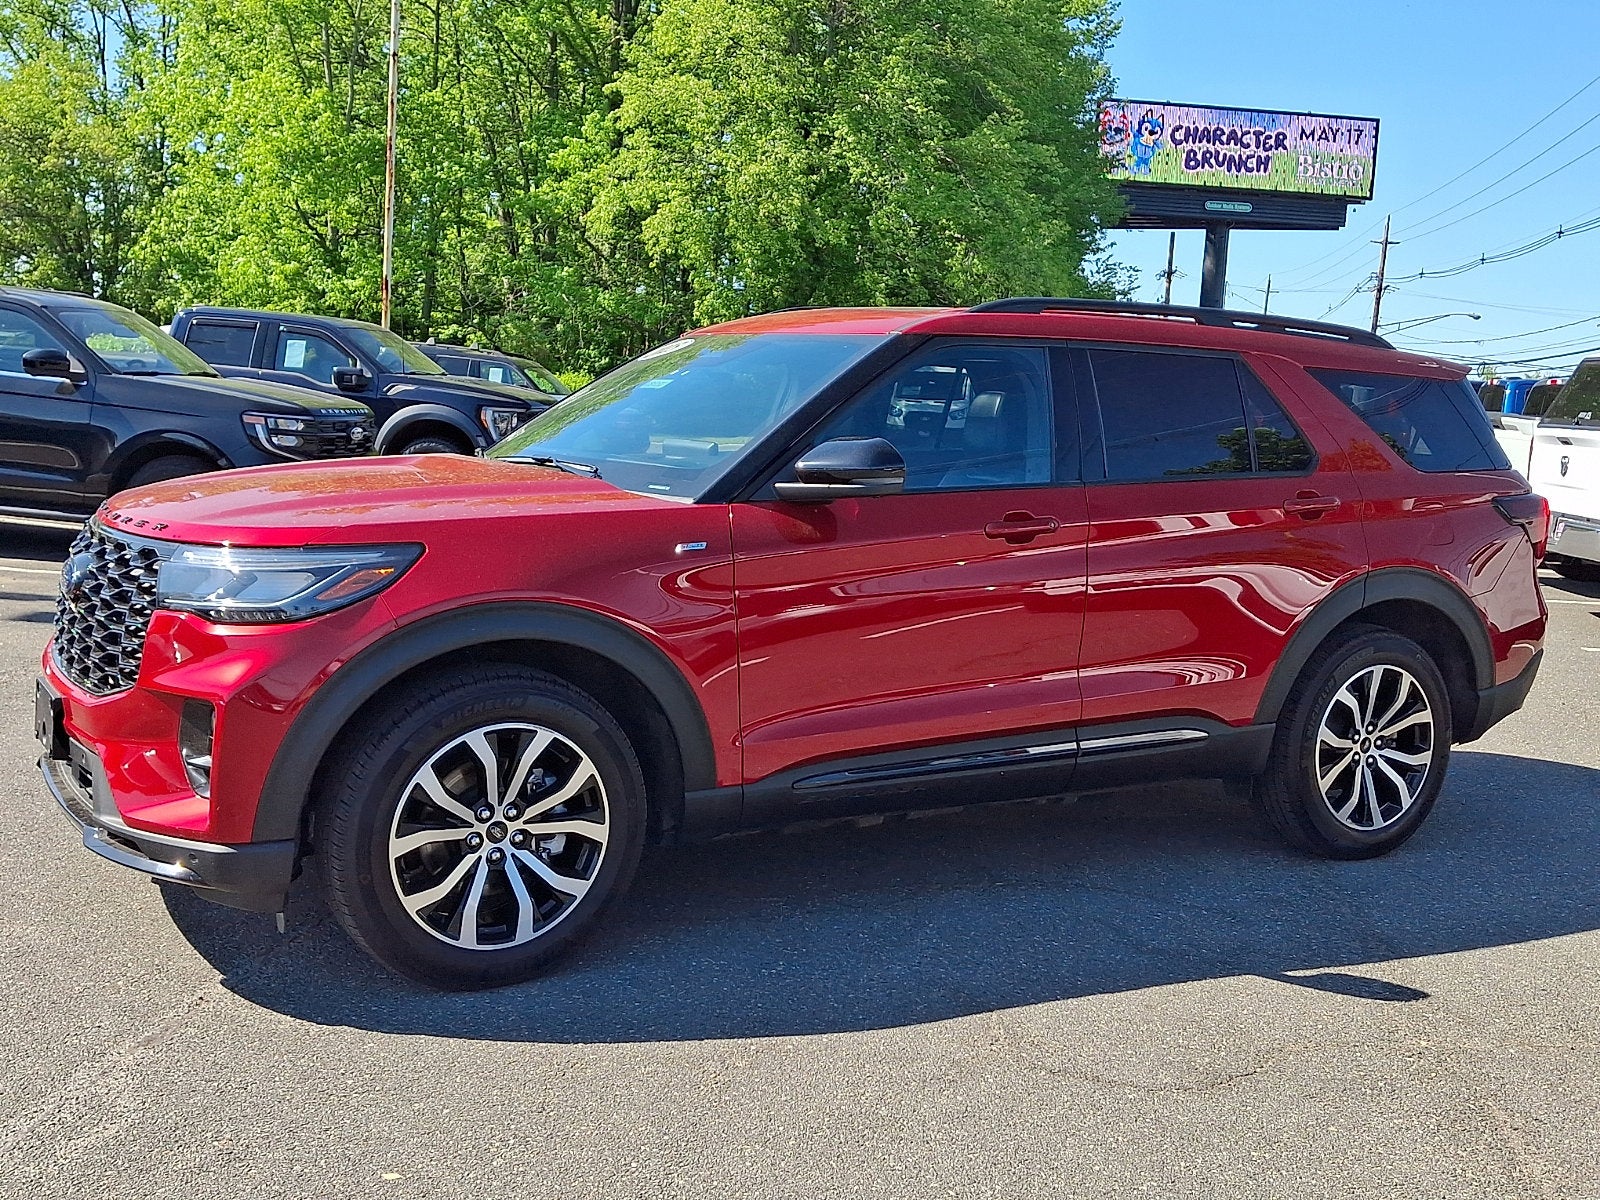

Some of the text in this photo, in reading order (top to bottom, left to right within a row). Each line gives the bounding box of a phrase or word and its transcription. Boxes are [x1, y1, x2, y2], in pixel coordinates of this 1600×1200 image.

[1170, 124, 1288, 151] CHARACTER
[1299, 125, 1364, 146] MAY 17
[1184, 149, 1270, 174] BRUNCH
